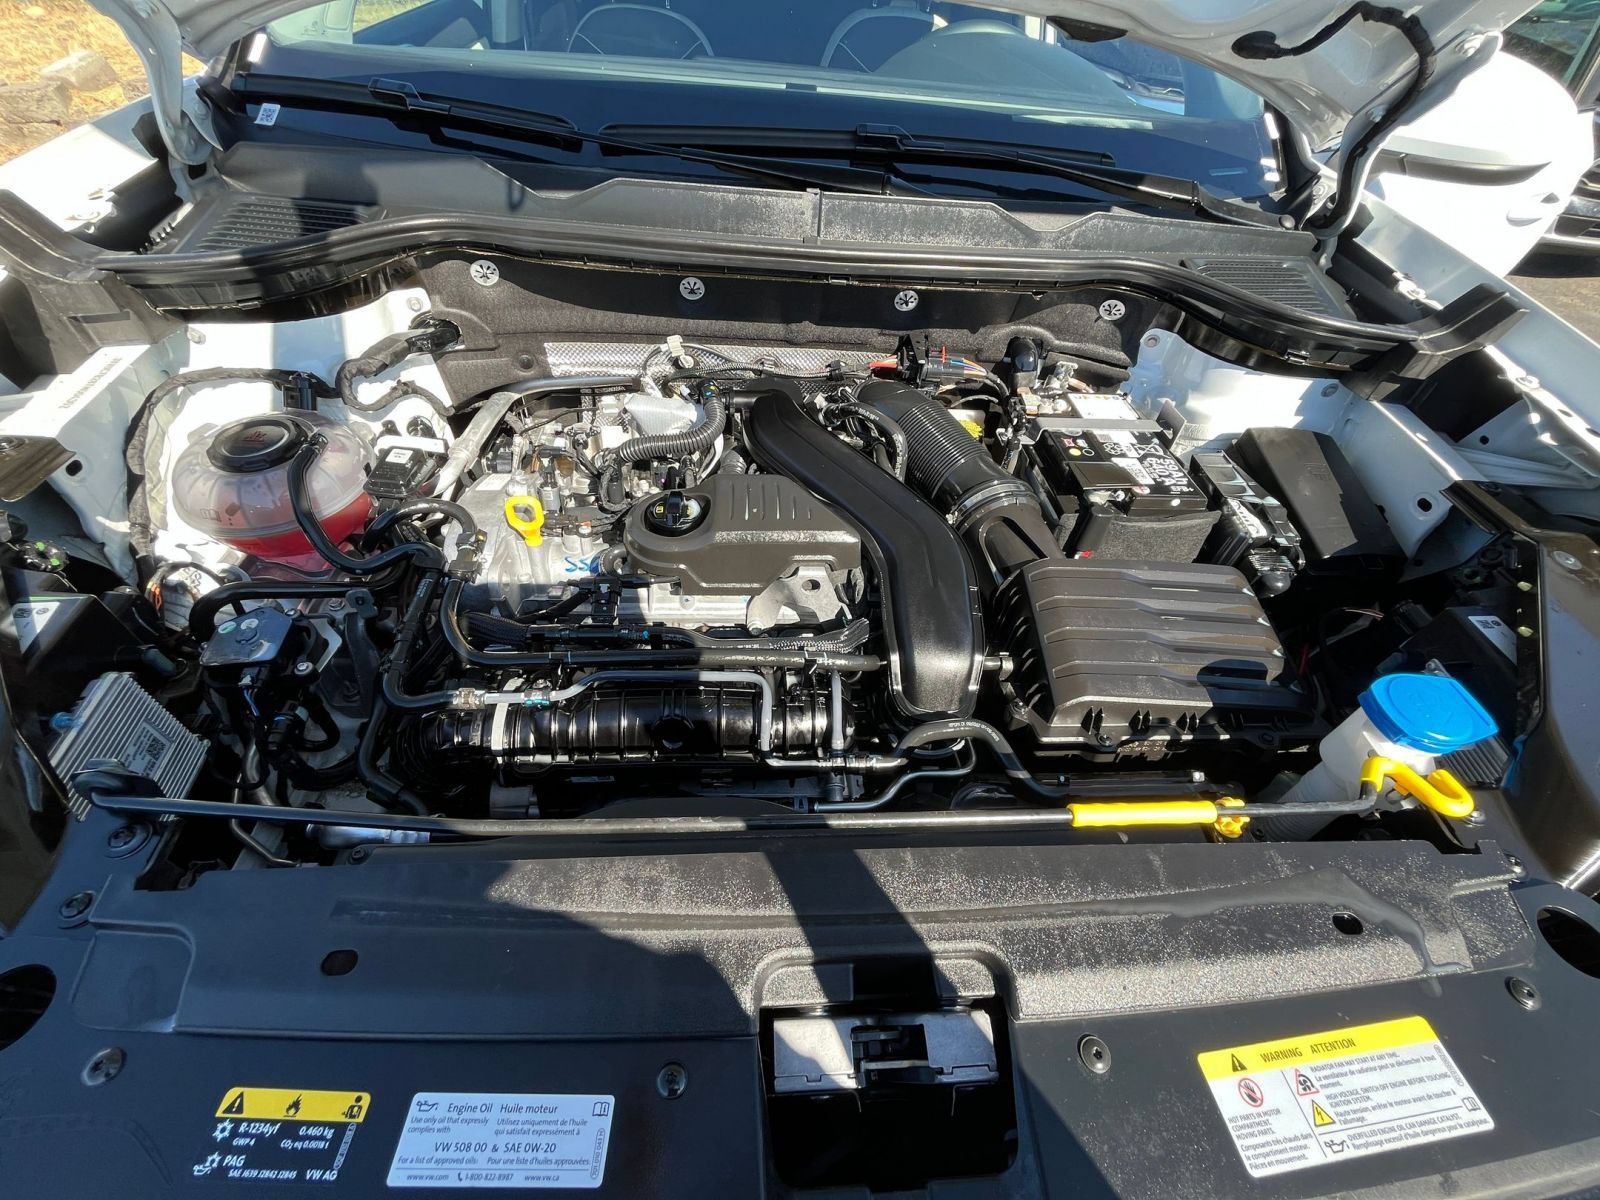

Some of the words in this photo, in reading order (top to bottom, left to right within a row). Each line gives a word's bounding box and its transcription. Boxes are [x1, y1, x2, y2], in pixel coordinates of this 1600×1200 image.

[1146, 458, 1170, 476] 640
[1160, 458, 1188, 485] 59Ah
[1260, 1048, 1302, 1062] WARNING
[1310, 1039, 1356, 1054] ATTENTION
[1310, 1063, 1334, 1072] RADIATOR
[1355, 1056, 1370, 1064] START
[1322, 1071, 1348, 1080] ventilateur
[1355, 1066, 1377, 1074] radiateur
[1377, 1063, 1389, 1071] peut
[1360, 1086, 1380, 1094] SWITCH
[1379, 1083, 1389, 1091] OFF
[1389, 1080, 1408, 1089] ENGINE
[1407, 1077, 1426, 1085] BEFORE
[448, 1103, 478, 1116] Engine
[479, 1103, 493, 1113] Oil
[500, 1103, 523, 1113] Huile
[525, 1104, 558, 1114] moteur
[1329, 1099, 1352, 1108] IGNITION
[1334, 1110, 1351, 1118] Haute
[1412, 1095, 1427, 1103] avant
[1432, 1091, 1452, 1099] toucher
[423, 1115, 437, 1126] only
[437, 1116, 447, 1124] oil
[460, 1117, 489, 1126] expressly
[1240, 1112, 1257, 1122] PARTS
[1262, 1108, 1281, 1117] MOTOR
[497, 1118, 520, 1126] Utilisez
[521, 1119, 559, 1127] uniquement
[569, 1118, 588, 1126] l'huile
[239, 1122, 281, 1137] R-1234yf
[299, 1126, 323, 1136] 0.460
[323, 1127, 334, 1139] kg
[408, 1126, 435, 1135] complies
[494, 1128, 505, 1136] qui
[506, 1127, 531, 1135] satisfait
[532, 1128, 575, 1136] expressément
[1235, 1131, 1258, 1140] MOVING
[1347, 1129, 1378, 1141] OVERFILLED
[1377, 1126, 1397, 1135] ENGINE
[1396, 1124, 1406, 1132] OIL
[1405, 1122, 1417, 1130] CAN
[1416, 1118, 1438, 1127] DAMAGE
[1240, 1141, 1273, 1152] Composants
[1283, 1134, 1300, 1144] chauds
[1300, 1132, 1314, 1140] dans
[1352, 1139, 1384, 1150] Remplissage
[1384, 1134, 1404, 1144] excessif
[1404, 1131, 1421, 1140] d'huile
[1421, 1127, 1447, 1136] dangereux
[1446, 1124, 1458, 1132] pour
[294, 1141, 303, 1150] eq
[435, 1142, 453, 1152] VW
[453, 1142, 472, 1153] 508
[474, 1142, 488, 1153] 00
[491, 1144, 499, 1153] &
[504, 1142, 522, 1153] SAE
[524, 1143, 556, 1153] 0W-20
[1252, 1146, 1289, 1161] compartiment
[223, 1155, 245, 1167] PAG
[398, 1155, 409, 1164] For
[415, 1156, 425, 1164] list
[434, 1157, 465, 1166] approved
[487, 1156, 502, 1165] Pour
[515, 1157, 529, 1165] liste
[529, 1157, 553, 1165] d'huiles
[228, 1169, 242, 1177] SAE
[306, 1169, 323, 1180] VW
[322, 1170, 338, 1180] AG
[465, 1173, 514, 1181] 1-800-822-8987
